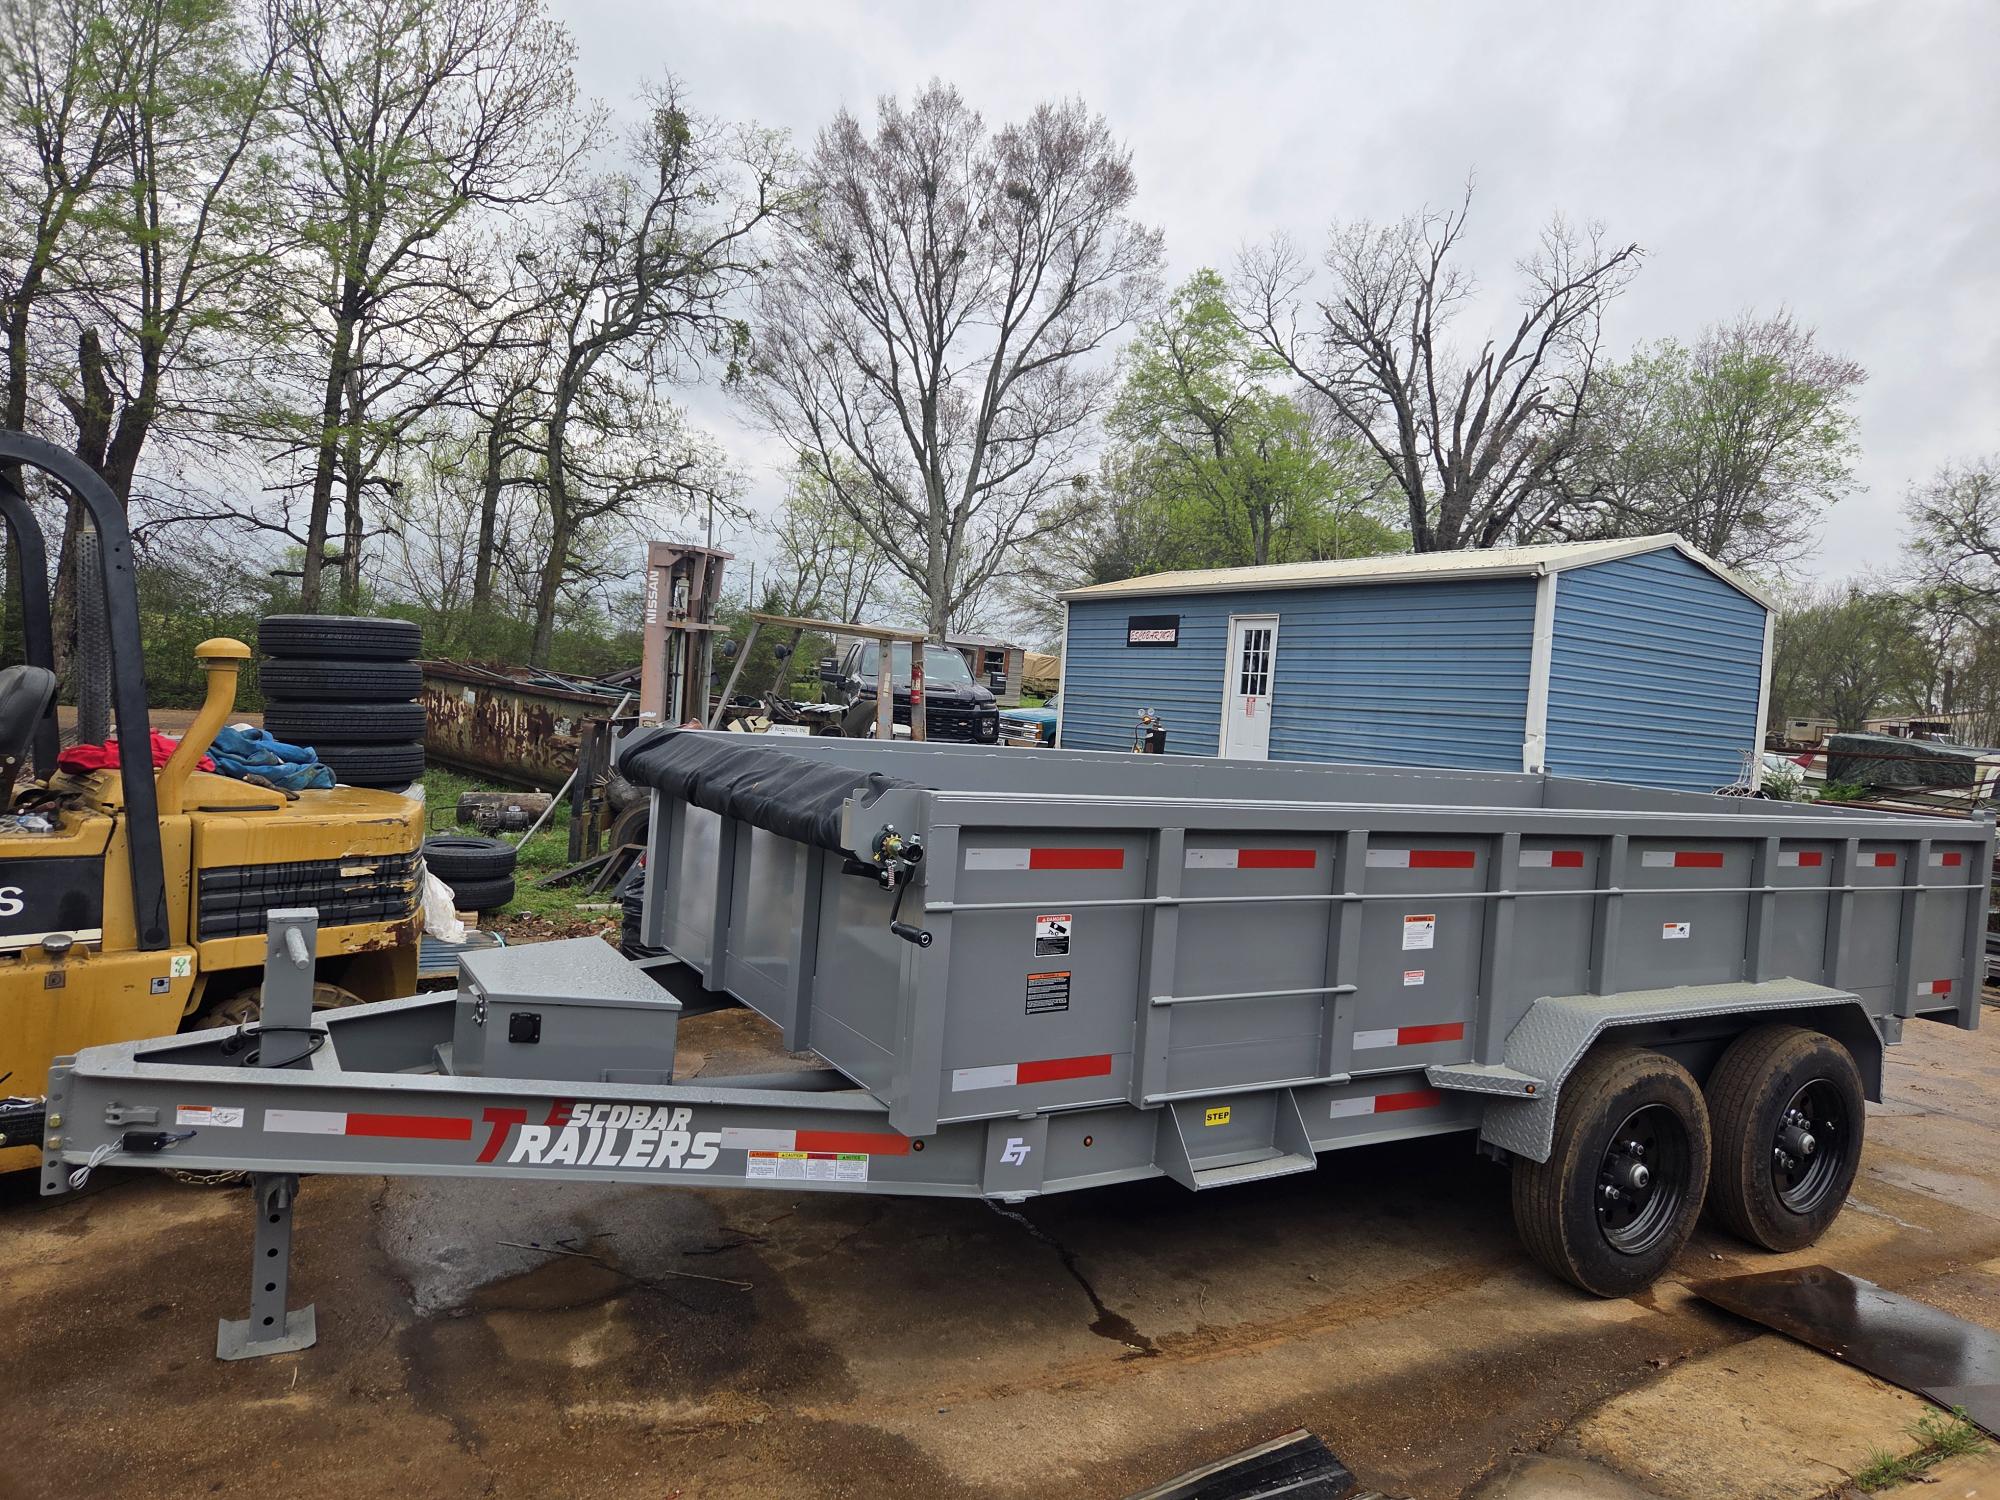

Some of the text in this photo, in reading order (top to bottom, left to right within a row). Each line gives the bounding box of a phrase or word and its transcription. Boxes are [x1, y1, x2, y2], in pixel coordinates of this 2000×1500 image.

[647, 571, 659, 623] NISSAN
[544, 1097, 693, 1131] ESCOBAR
[1207, 1111, 1229, 1121] STEP
[476, 1107, 722, 1170] TRAILERS
